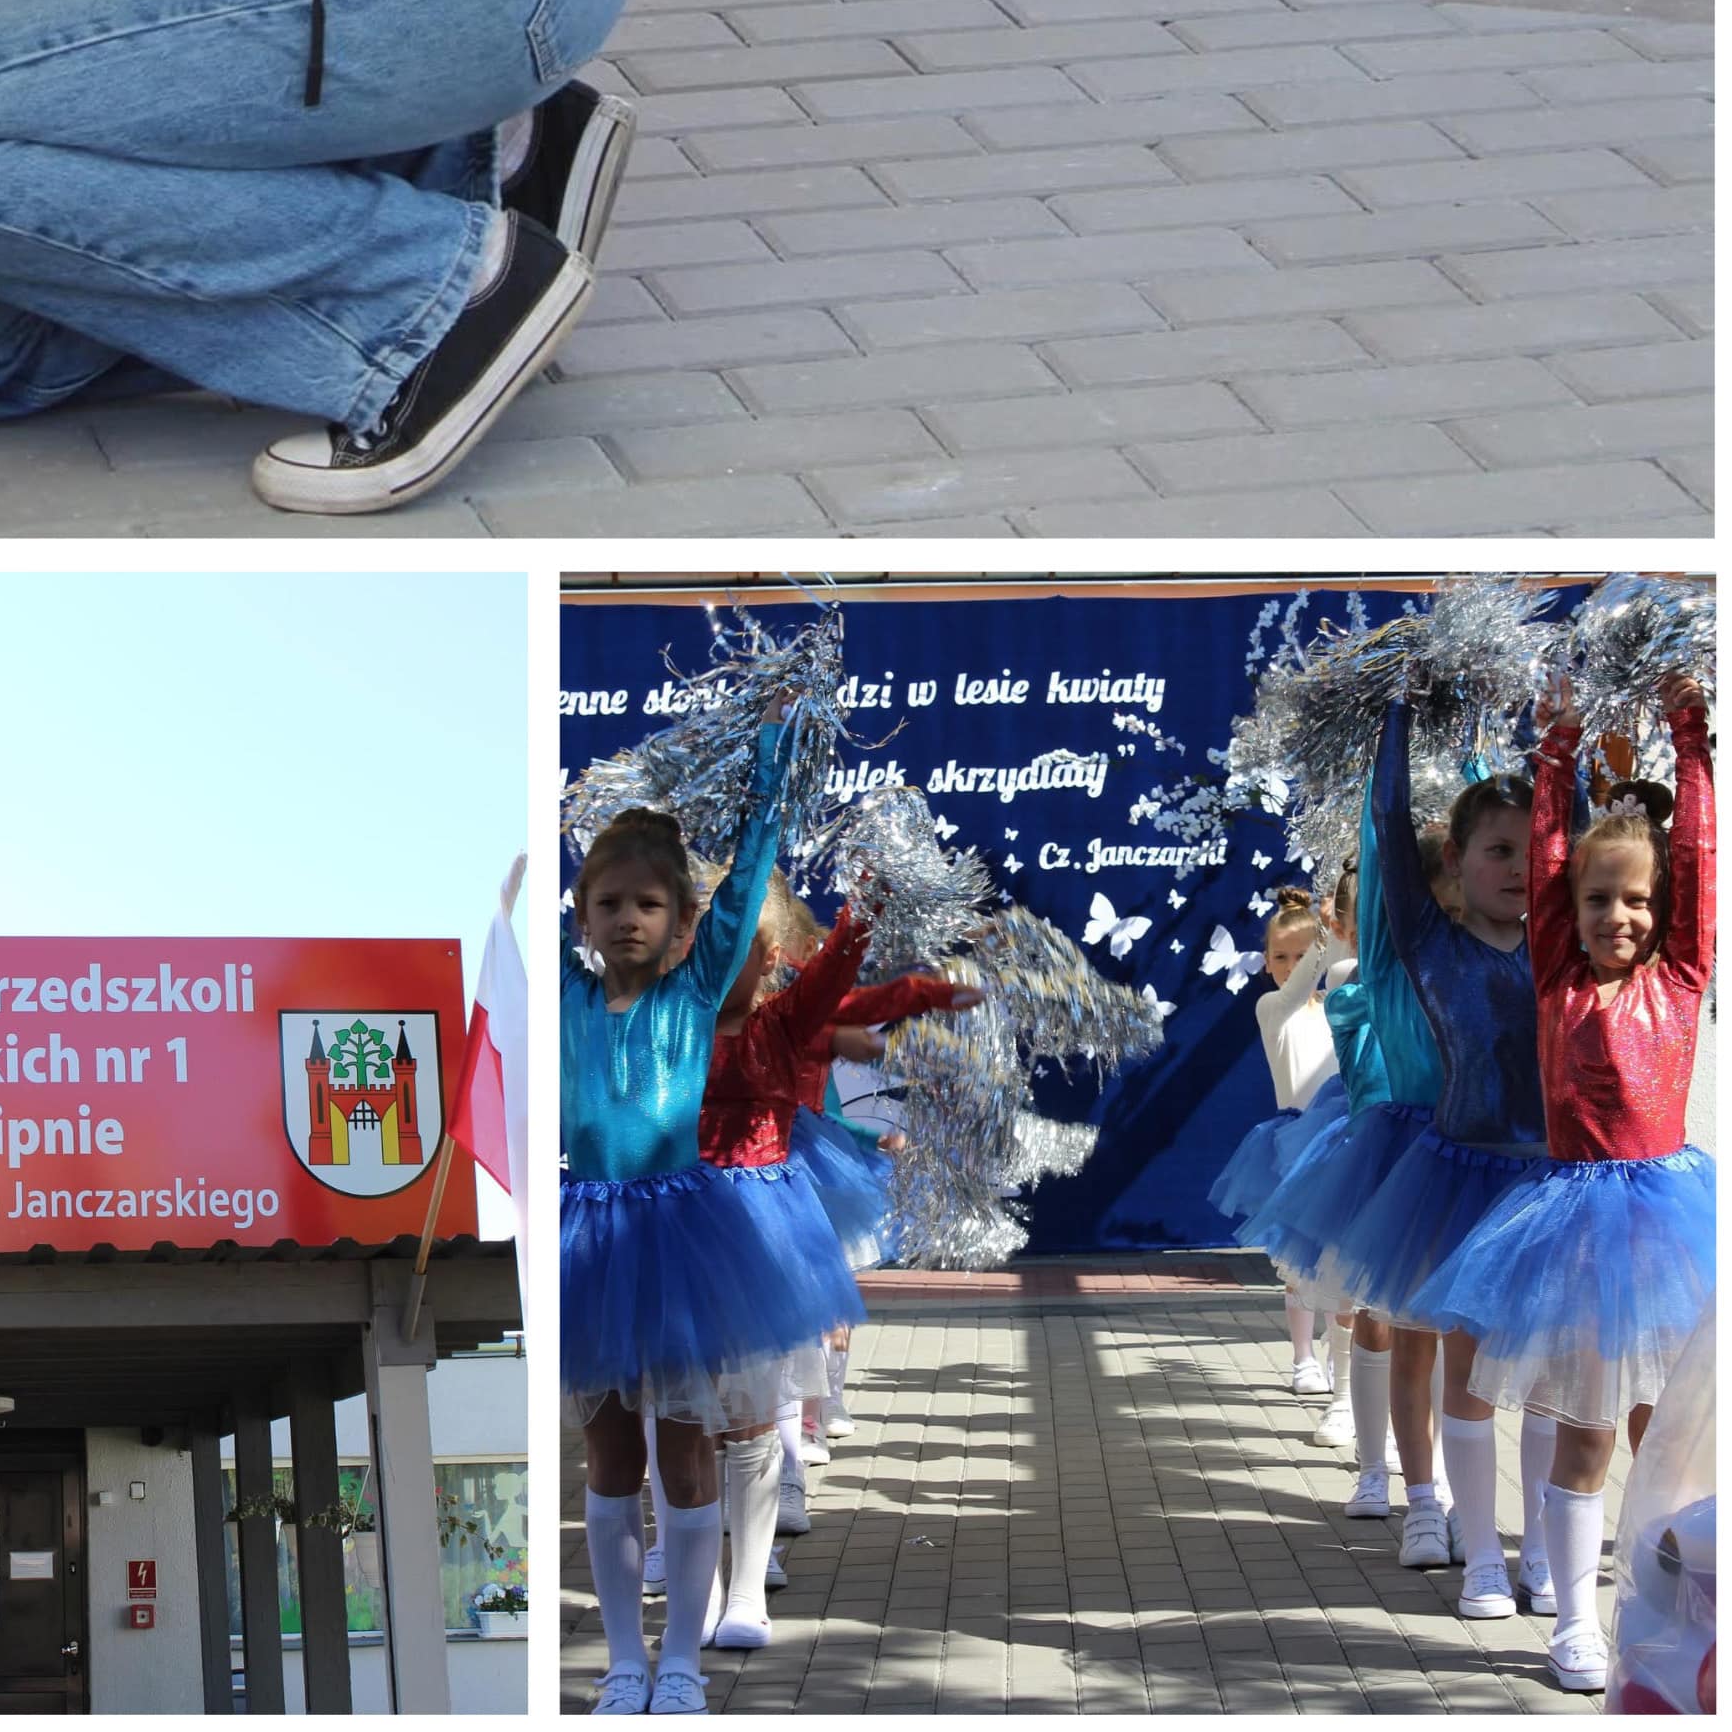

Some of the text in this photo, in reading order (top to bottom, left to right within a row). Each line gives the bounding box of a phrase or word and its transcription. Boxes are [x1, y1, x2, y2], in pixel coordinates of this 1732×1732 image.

[560, 690, 629, 716] enne
[836, 671, 895, 709] dzi
[908, 680, 937, 707] w
[954, 669, 1030, 706] lesie
[1046, 669, 1166, 713] kwiaty
[824, 760, 907, 804] tylek
[95, 1047, 151, 1083] nr
[166, 1037, 188, 1083] 1
[8, 1177, 280, 1229] Janczarskiego
